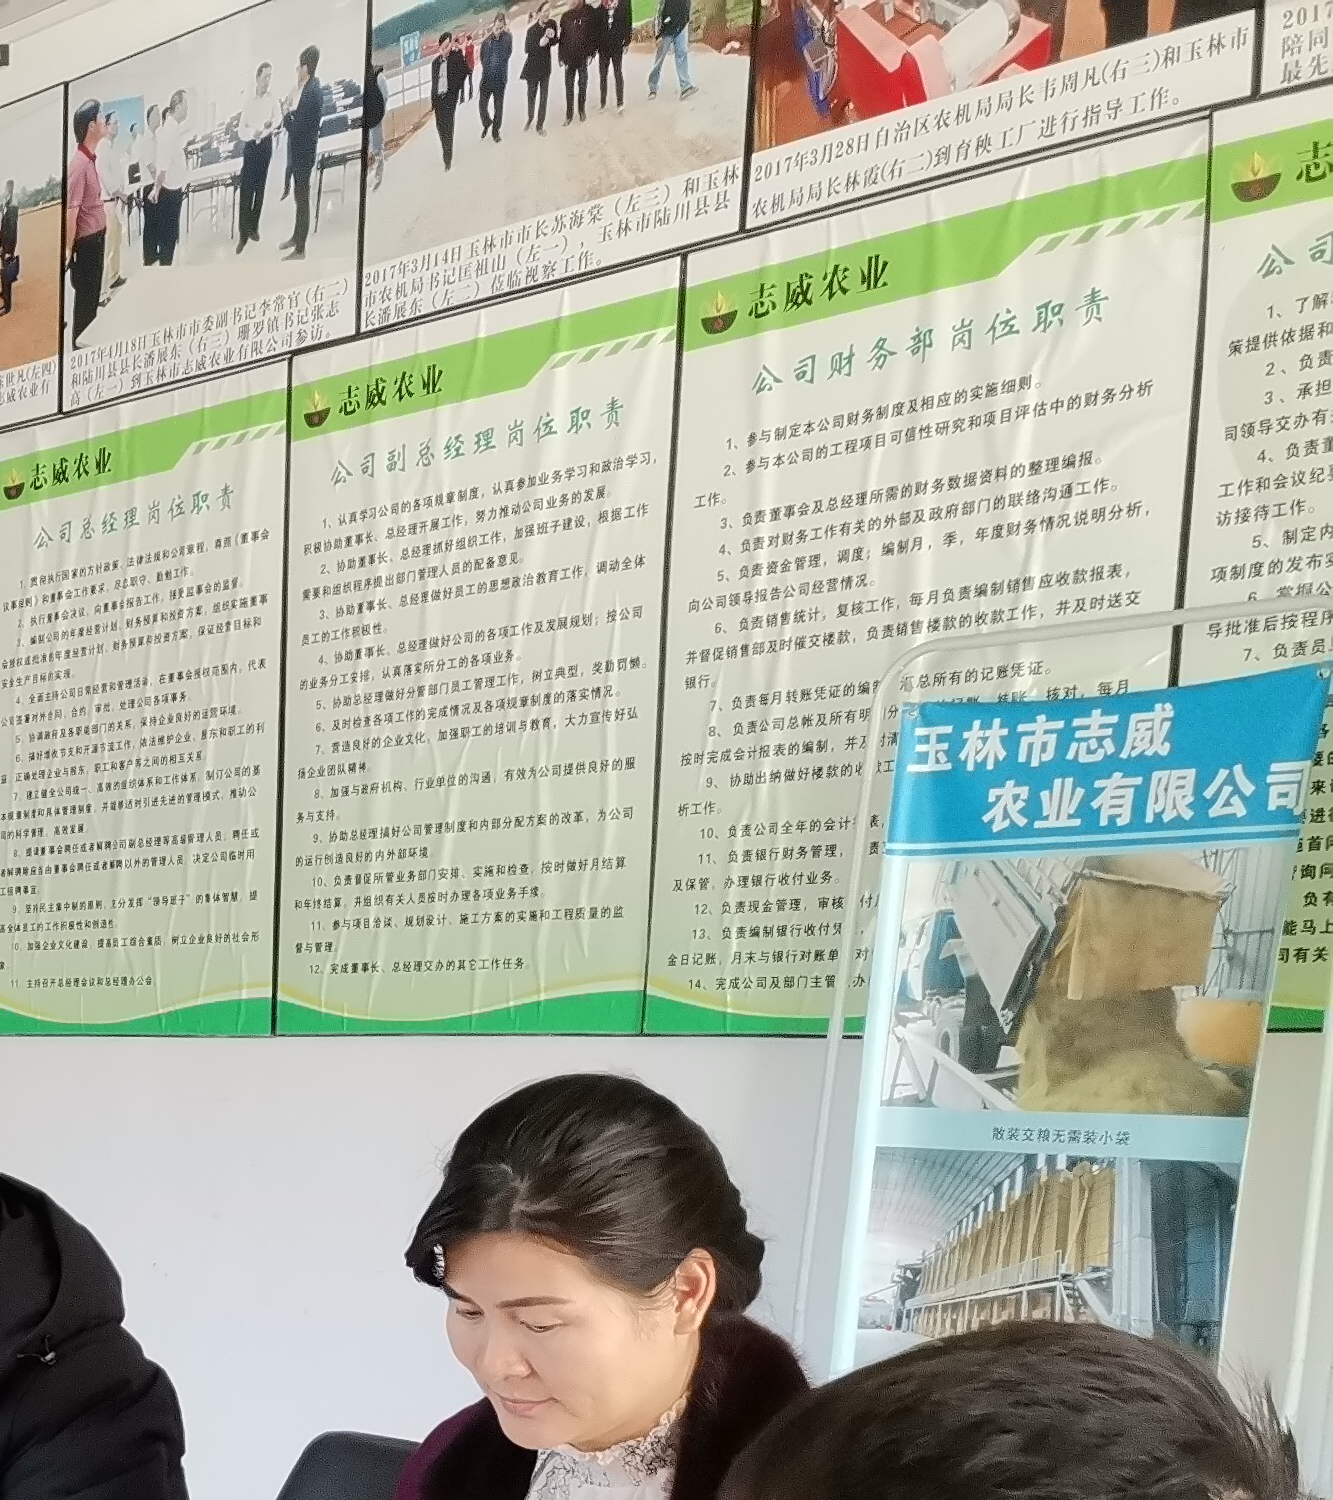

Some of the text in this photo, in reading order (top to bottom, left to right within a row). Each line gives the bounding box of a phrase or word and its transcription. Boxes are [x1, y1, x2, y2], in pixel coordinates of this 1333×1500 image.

[1281, 27, 1329, 59] 陪同
[1280, 53, 1329, 84] 最先
[747, 254, 890, 321] 志威农业
[751, 287, 1110, 396] 公司财务部岗位职责
[338, 364, 443, 416] 志威农业
[330, 397, 624, 487] 公司副总经理岗位职责
[29, 447, 112, 491] 志威农业
[33, 482, 235, 550] 公司总经理岗位职责
[693, 488, 729, 511] 工作。
[1216, 498, 1316, 528] 访接待工作。
[683, 672, 718, 692] 银行。
[906, 702, 1174, 774] 玉林市志威
[981, 759, 1312, 833] 农业有限公司
[991, 1126, 1131, 1147] 散装交粮无需装小袋
